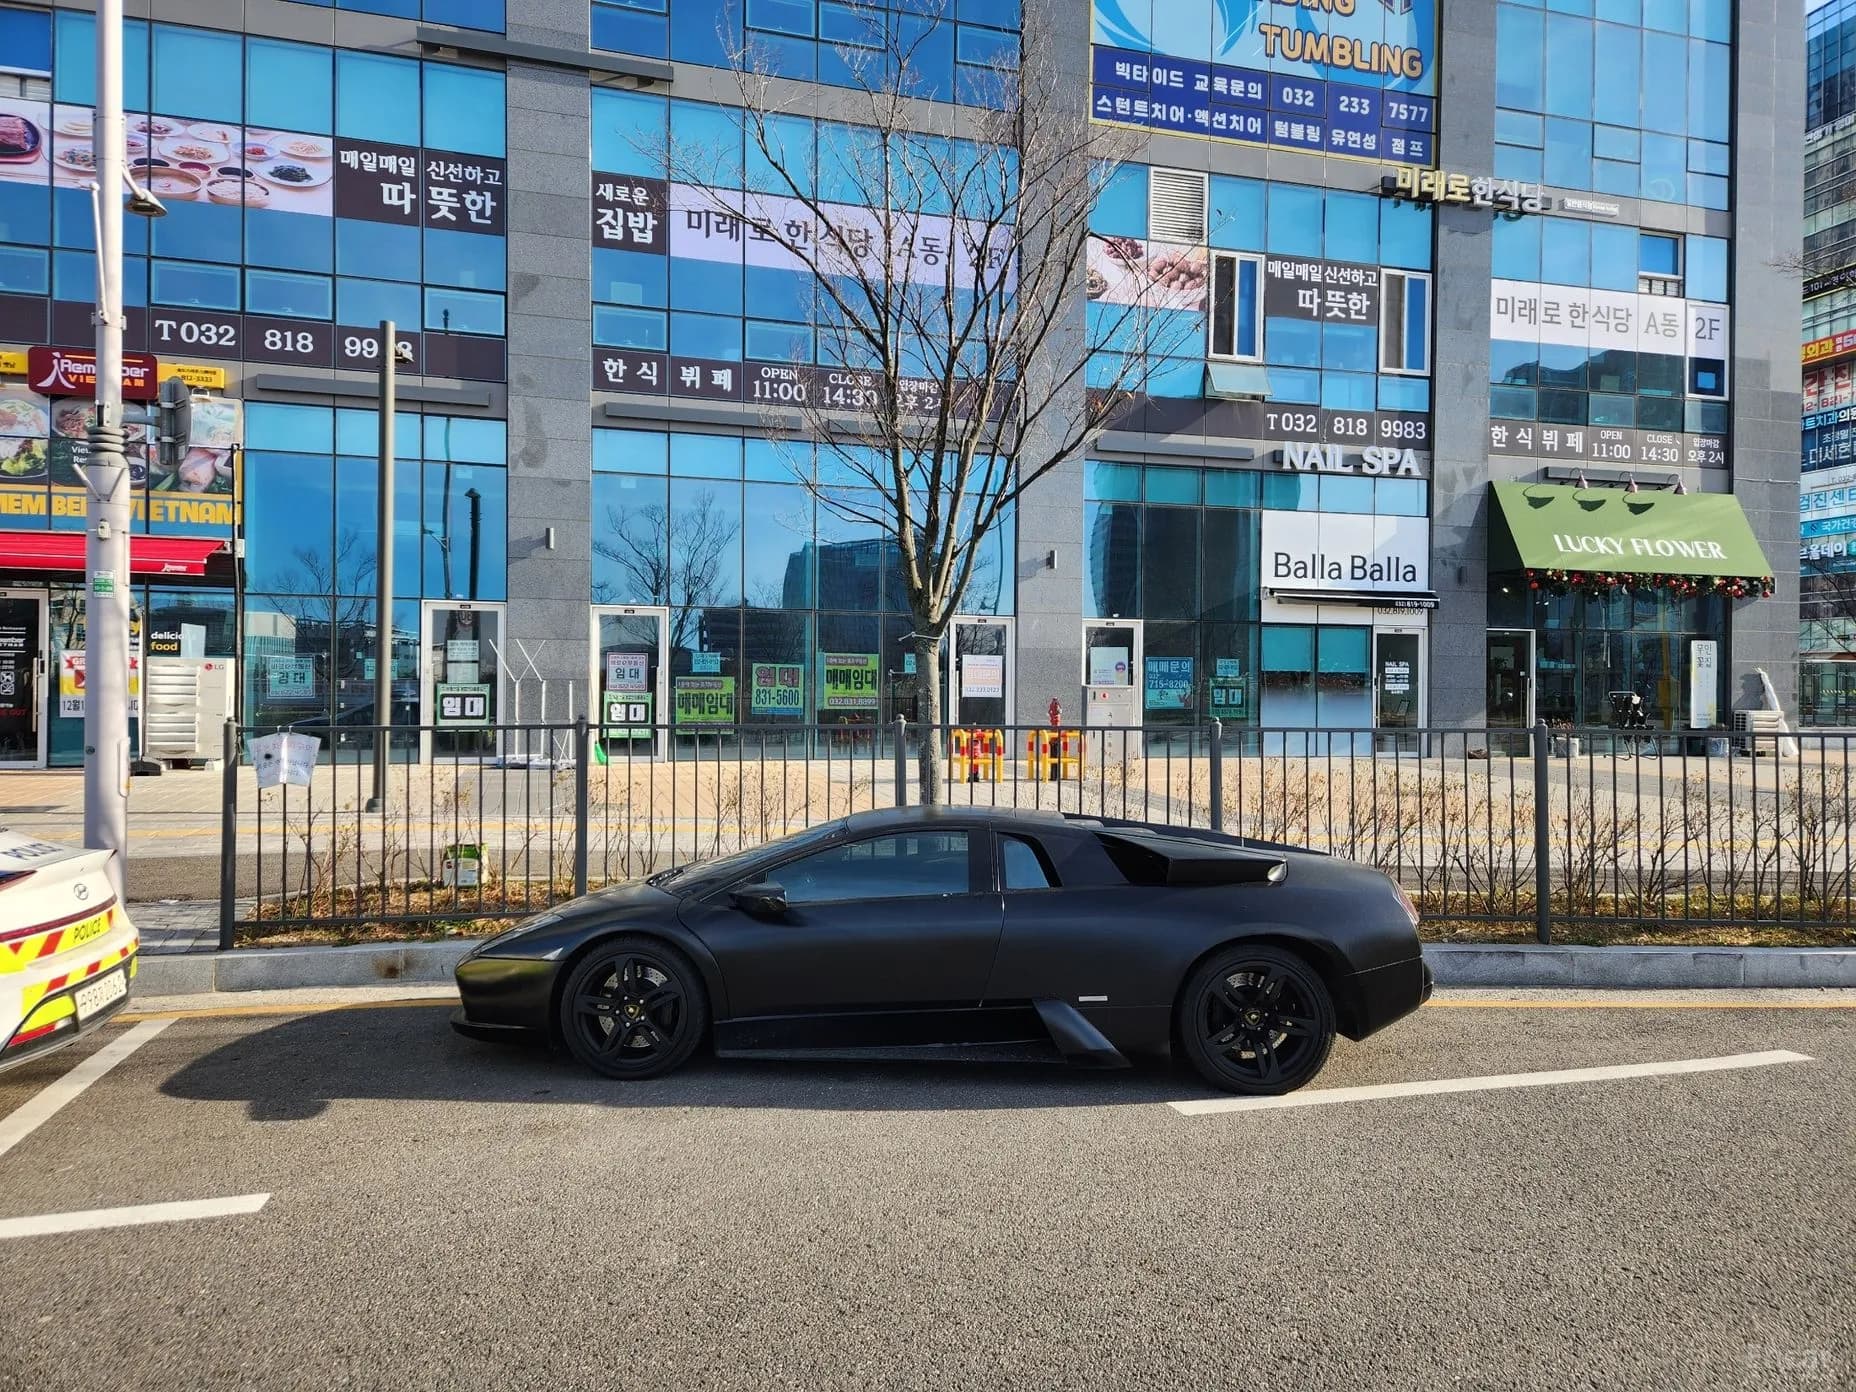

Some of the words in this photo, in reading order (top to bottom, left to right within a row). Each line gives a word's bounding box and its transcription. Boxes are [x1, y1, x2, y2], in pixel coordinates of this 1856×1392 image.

[1259, 23, 1424, 79] TUMBLING
[1115, 61, 1184, 89] 빅타이드
[1194, 73, 1262, 100] 교육문의
[1282, 87, 1315, 107] 032
[1339, 95, 1370, 115] 233
[1389, 102, 1428, 123] 7577
[1275, 120, 1320, 142] 텀블링
[1331, 129, 1376, 151] 유연성
[1392, 137, 1424, 158] 점프
[340, 149, 416, 177] 매일매일
[426, 160, 503, 186] 신선하고
[381, 182, 496, 225] 따뜻한
[596, 183, 649, 206] 새로운
[595, 208, 658, 244] 집밥
[686, 209, 776, 243] 미래로
[1267, 260, 1322, 282] 매일매일
[1324, 265, 1378, 288] 신선하고
[1298, 288, 1370, 320] 따뜻한
[1496, 296, 1562, 326] 미래로
[1568, 302, 1632, 334] 한식당
[1645, 311, 1680, 339] A동
[1695, 316, 1721, 340] 2F
[264, 330, 314, 353] 818
[60, 358, 150, 378] Remer
[761, 366, 799, 381] OPEN
[68, 374, 145, 387] VIEAM
[753, 380, 806, 402] 11:00
[1333, 417, 1367, 436] 818
[1381, 420, 1426, 440] 9983
[1599, 430, 1623, 441] OPEN
[1646, 433, 1672, 446] CLOSE
[1282, 442, 1353, 473] NAIL
[1362, 446, 1422, 476] SPA
[1592, 443, 1631, 460] 11:00
[1640, 446, 1679, 463] 14:30
[1553, 534, 1624, 557] LUCKY
[1630, 537, 1728, 560] FLOWER
[1273, 551, 1342, 580] Balla
[1351, 554, 1417, 582] Balla
[151, 641, 178, 651] food
[825, 668, 877, 690] 매매임대
[678, 692, 733, 714] 매매임대
[755, 688, 800, 706] 831-5600
